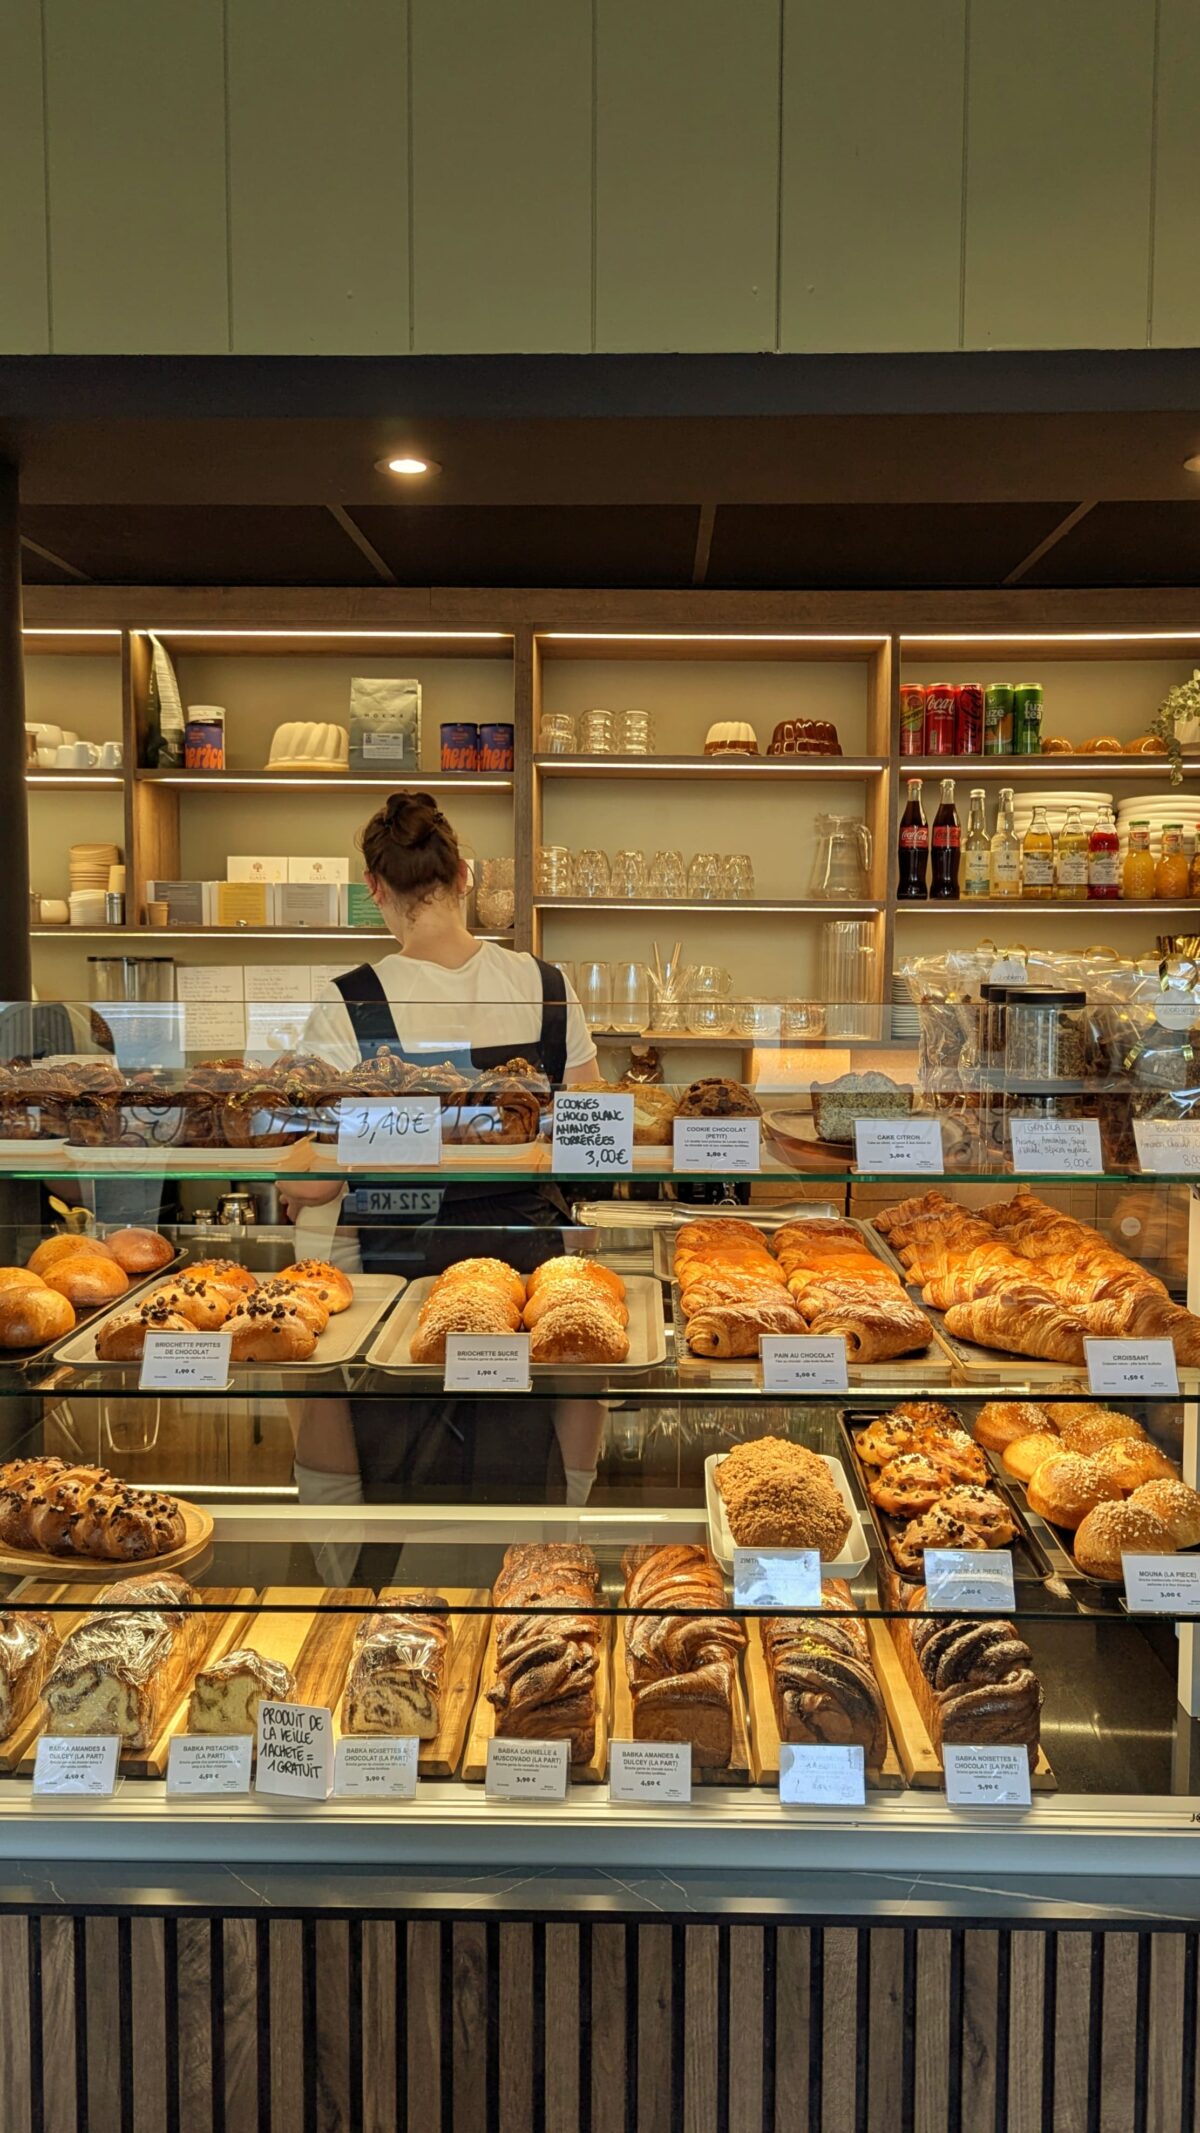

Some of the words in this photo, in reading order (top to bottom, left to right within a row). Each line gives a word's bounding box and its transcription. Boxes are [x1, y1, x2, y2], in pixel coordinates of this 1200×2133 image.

[556, 1111, 589, 1122] CHOCO
[591, 1110, 624, 1121] BLANC
[356, 1111, 430, 1145] 3,40€
[585, 1148, 629, 1168] 3,00€
[262, 1707, 305, 1728] PRODUIT
[309, 1715, 324, 1731] DE
[263, 1726, 276, 1740] LA
[281, 1728, 313, 1745] VEILLE
[492, 1755, 531, 1763] MUSCOVADO
[543, 1757, 562, 1765] PART)
